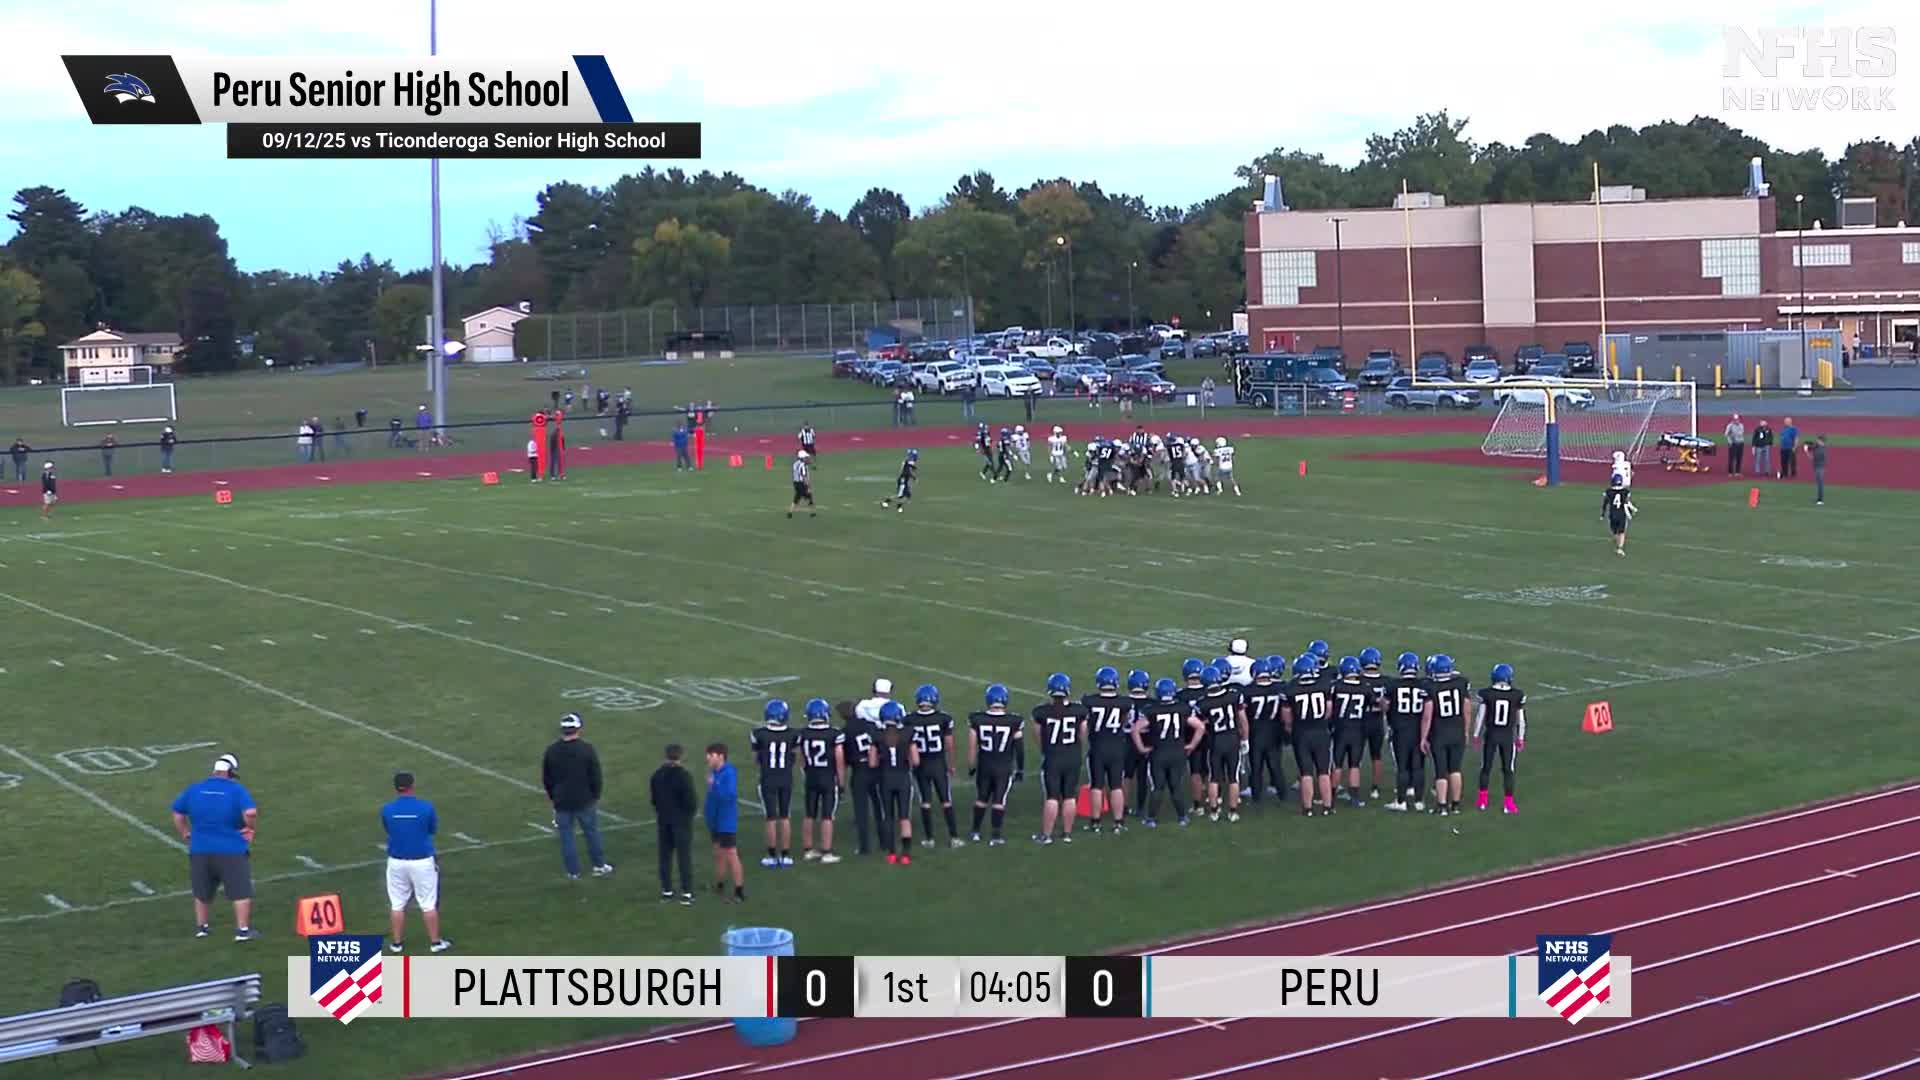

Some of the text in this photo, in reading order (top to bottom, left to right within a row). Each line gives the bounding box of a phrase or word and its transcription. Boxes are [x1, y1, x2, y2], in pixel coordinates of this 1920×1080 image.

[1613, 493, 1621, 509] 4
[1251, 695, 1280, 720] 77
[1295, 692, 1326, 720] 70
[1336, 693, 1365, 719] 73
[1397, 687, 1424, 713] 66
[1438, 688, 1460, 717] 61
[1494, 699, 1510, 726] 0
[1046, 716, 1076, 744] 75
[1091, 706, 1121, 734] 74
[1156, 712, 1180, 739] 71
[1210, 703, 1235, 733] 21
[1594, 705, 1609, 728] 20
[979, 725, 1011, 752] 57
[769, 741, 787, 769] 11
[803, 739, 828, 767] 12
[310, 900, 337, 930] 40
